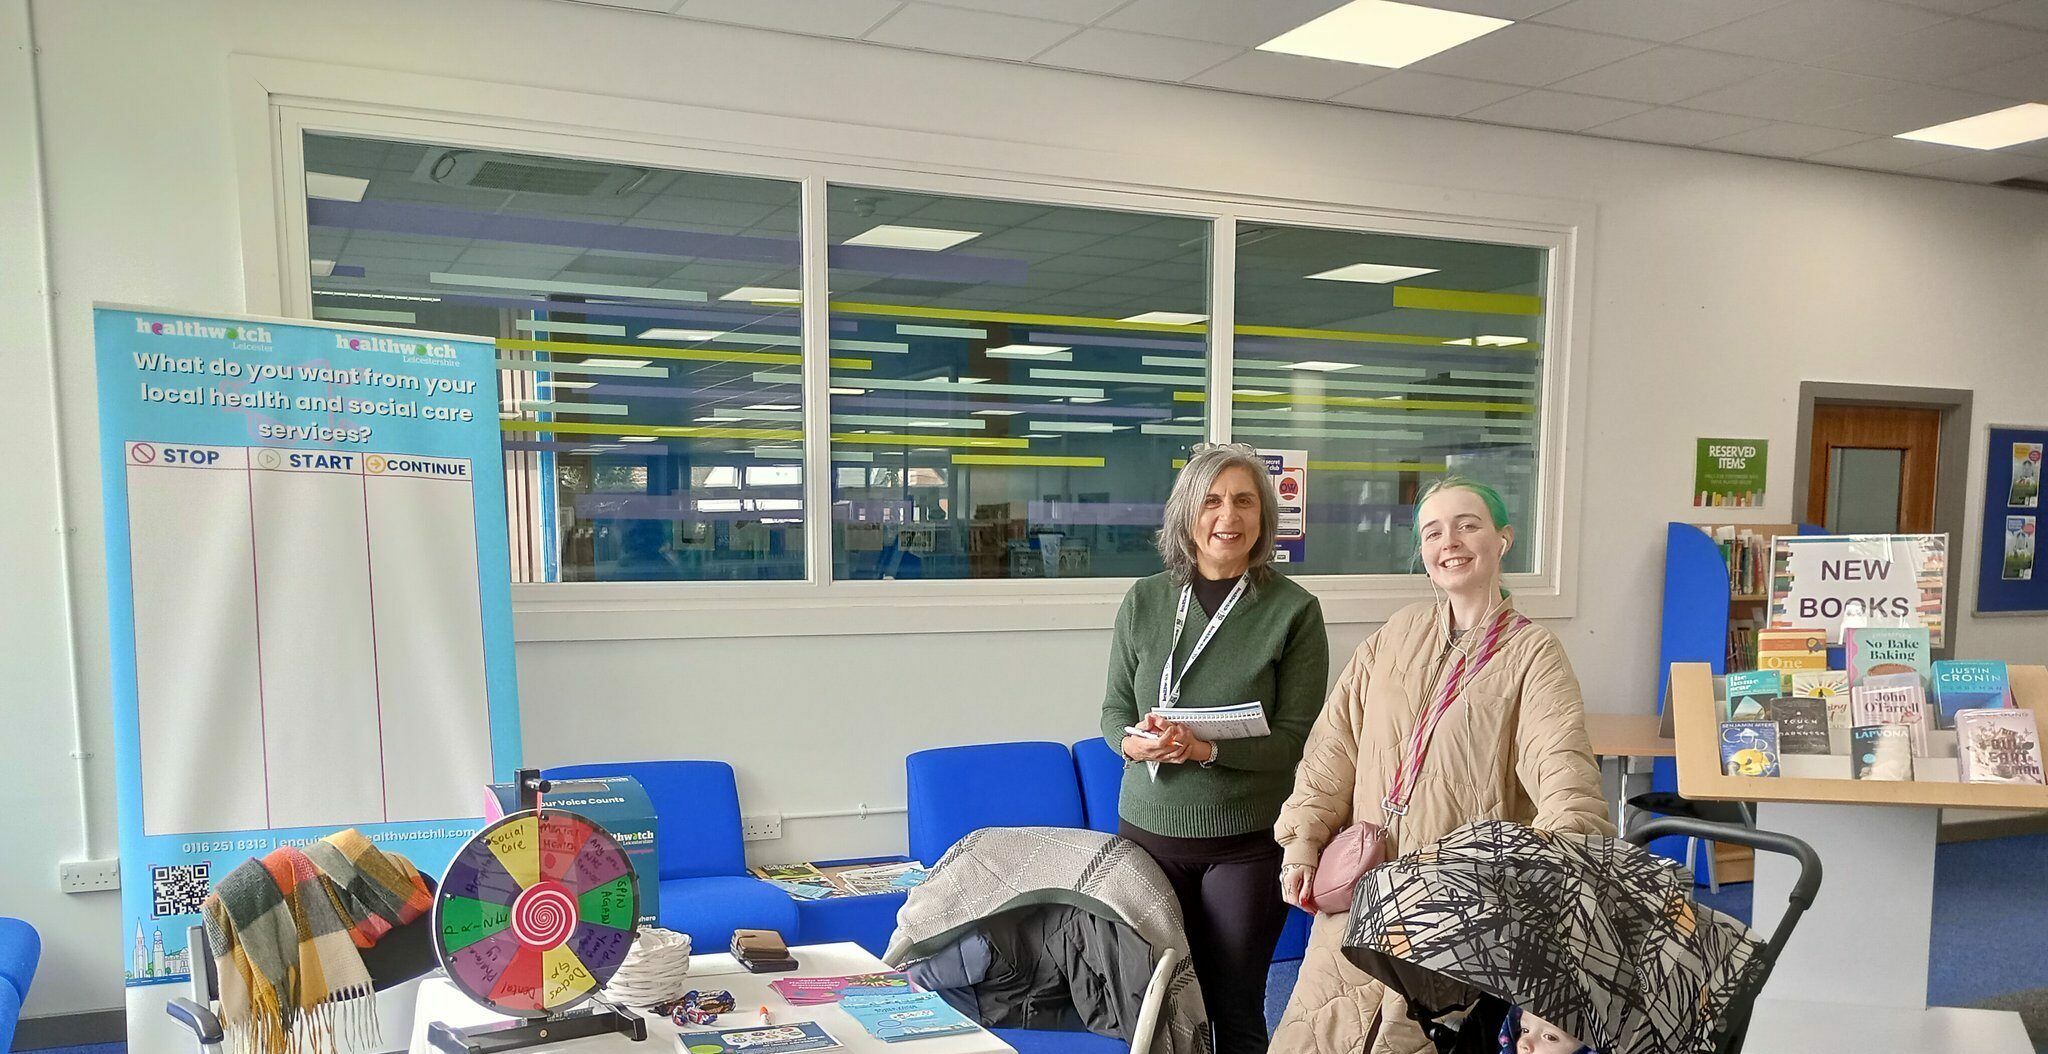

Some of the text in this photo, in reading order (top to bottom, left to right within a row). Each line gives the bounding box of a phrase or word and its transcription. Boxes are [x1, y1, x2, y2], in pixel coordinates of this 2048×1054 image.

[136, 317, 272, 343] healthwatch
[232, 341, 273, 352] Leicester
[335, 334, 456, 359] healthwatch
[403, 355, 460, 367] Leicestershire
[133, 352, 477, 396] What do you want from your
[141, 383, 474, 423] local health and social care
[259, 422, 373, 444] services?
[163, 448, 220, 466] STOP
[1709, 445, 1756, 458] RESERVED
[289, 454, 354, 472] START
[386, 460, 467, 477] CONTINUE
[1719, 457, 1746, 469] ITEMS
[1821, 560, 1892, 581] NEW
[1865, 639, 1920, 649] No Bake
[1767, 656, 1803, 670] One
[1870, 649, 1916, 662] Baking
[1941, 673, 2001, 682] CRONIN
[1874, 692, 1907, 702] John
[1865, 702, 1919, 713] O'Farrell
[1855, 729, 1909, 740] LAPVONA
[559, 798, 587, 807] Voice
[589, 796, 625, 806] Counts
[491, 825, 524, 846] Social
[182, 842, 210, 854] 0116
[213, 841, 235, 852] 251
[237, 839, 268, 851] 8313
[502, 840, 526, 854] Care
[616, 880, 628, 909] SPIN
[501, 982, 535, 1000] Dental
[550, 967, 586, 1000] Doctors
